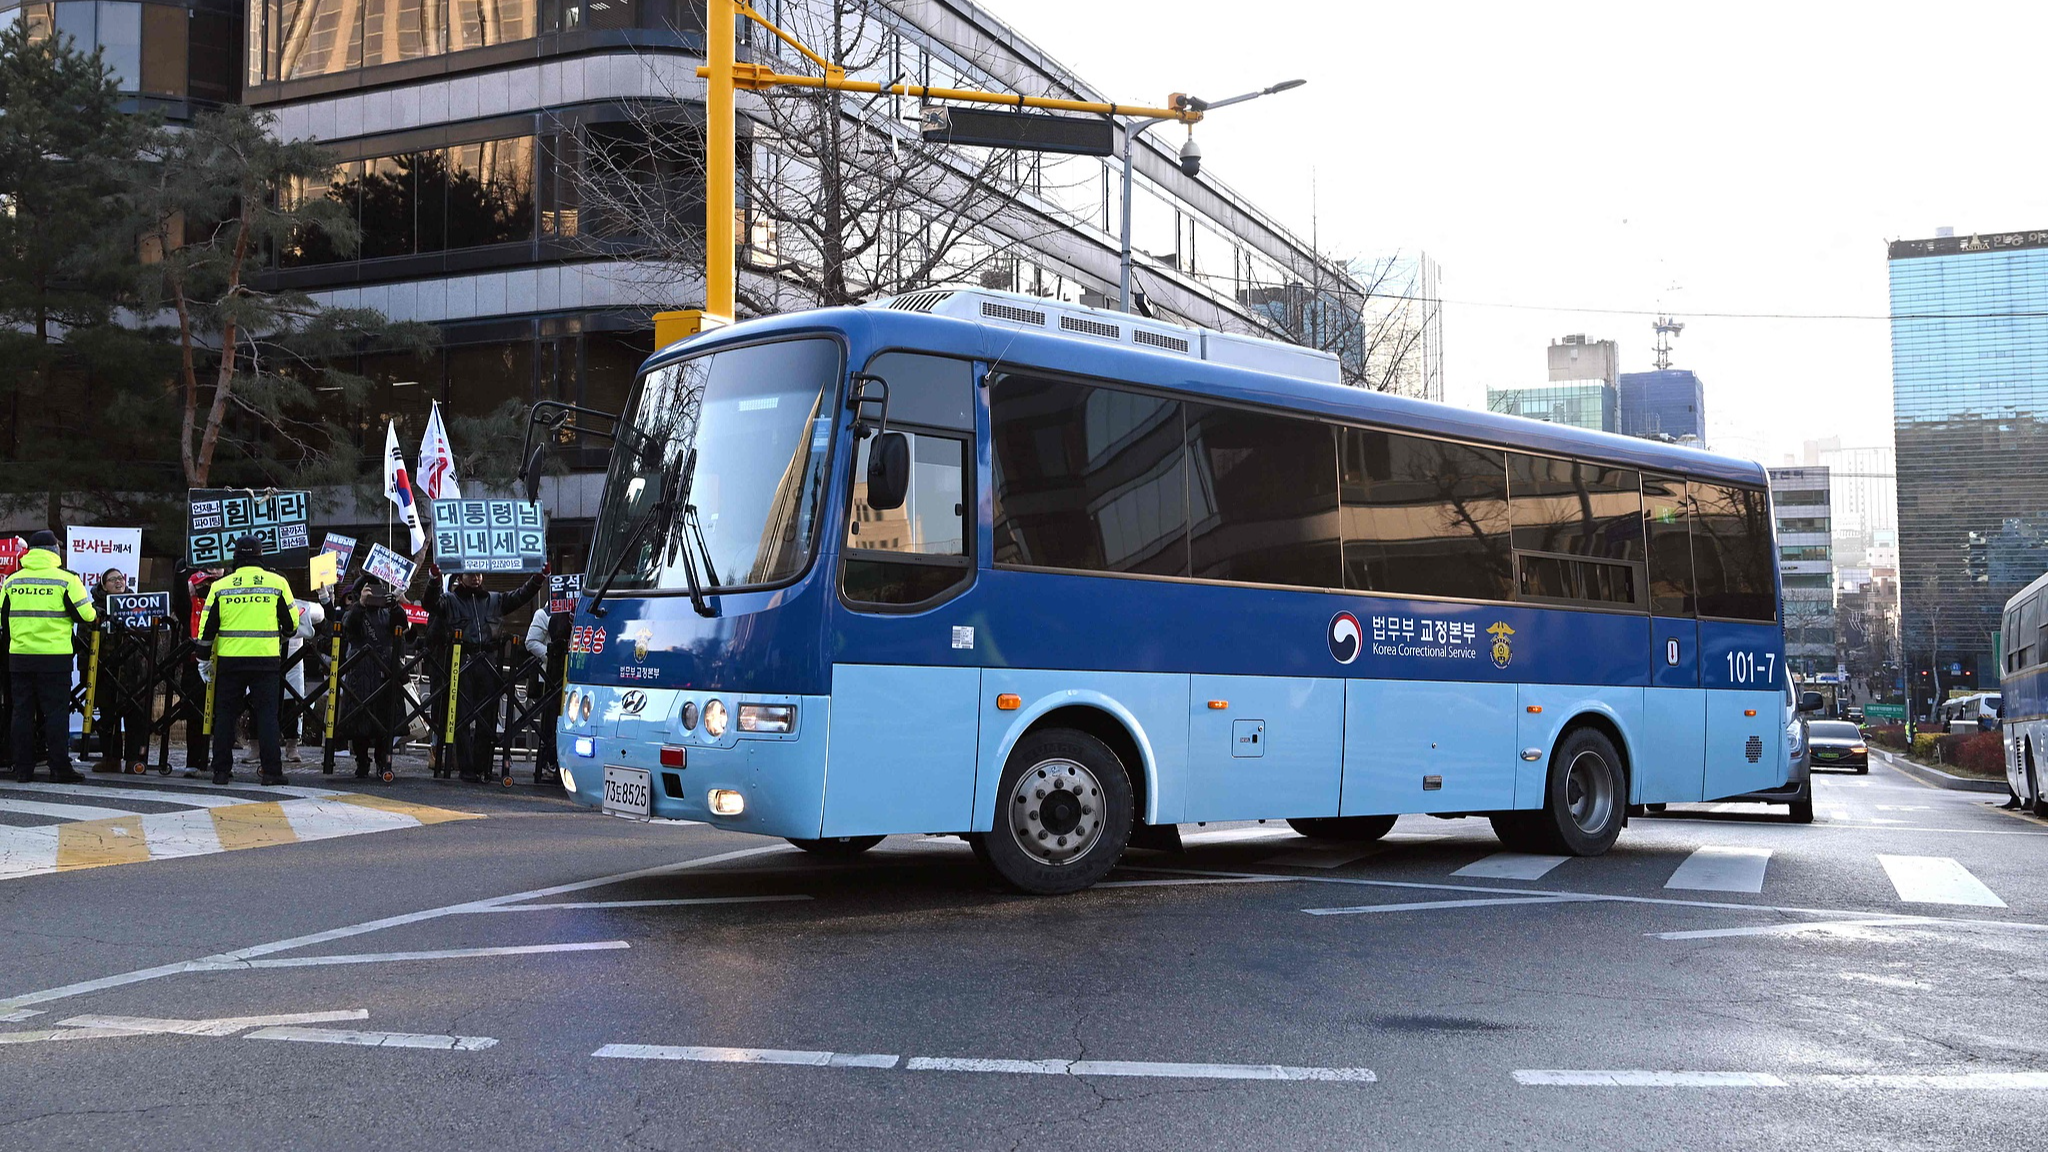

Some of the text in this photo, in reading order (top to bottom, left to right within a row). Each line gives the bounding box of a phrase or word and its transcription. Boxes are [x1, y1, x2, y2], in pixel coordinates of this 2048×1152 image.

[192, 503, 220, 513] 언제나
[224, 494, 305, 526] 힘내라
[436, 503, 538, 525] 대통령님
[194, 516, 221, 527] 파이팅
[280, 525, 306, 536] 끝까지
[72, 539, 132, 554] 판사님께서
[438, 531, 541, 554] 힘내세요
[551, 575, 580, 591] 윤석
[10, 587, 54, 596] POLICE
[116, 596, 160, 609] YOON
[225, 595, 271, 605] POLICE
[551, 599, 579, 612] 힘내
[1372, 616, 1476, 644] 법무부 교정본부
[1372, 642, 1476, 659] Korea Correctional Service
[1727, 651, 1776, 683] 101-7
[451, 661, 459, 701] POLICE
[604, 779, 648, 808] 73도8525
